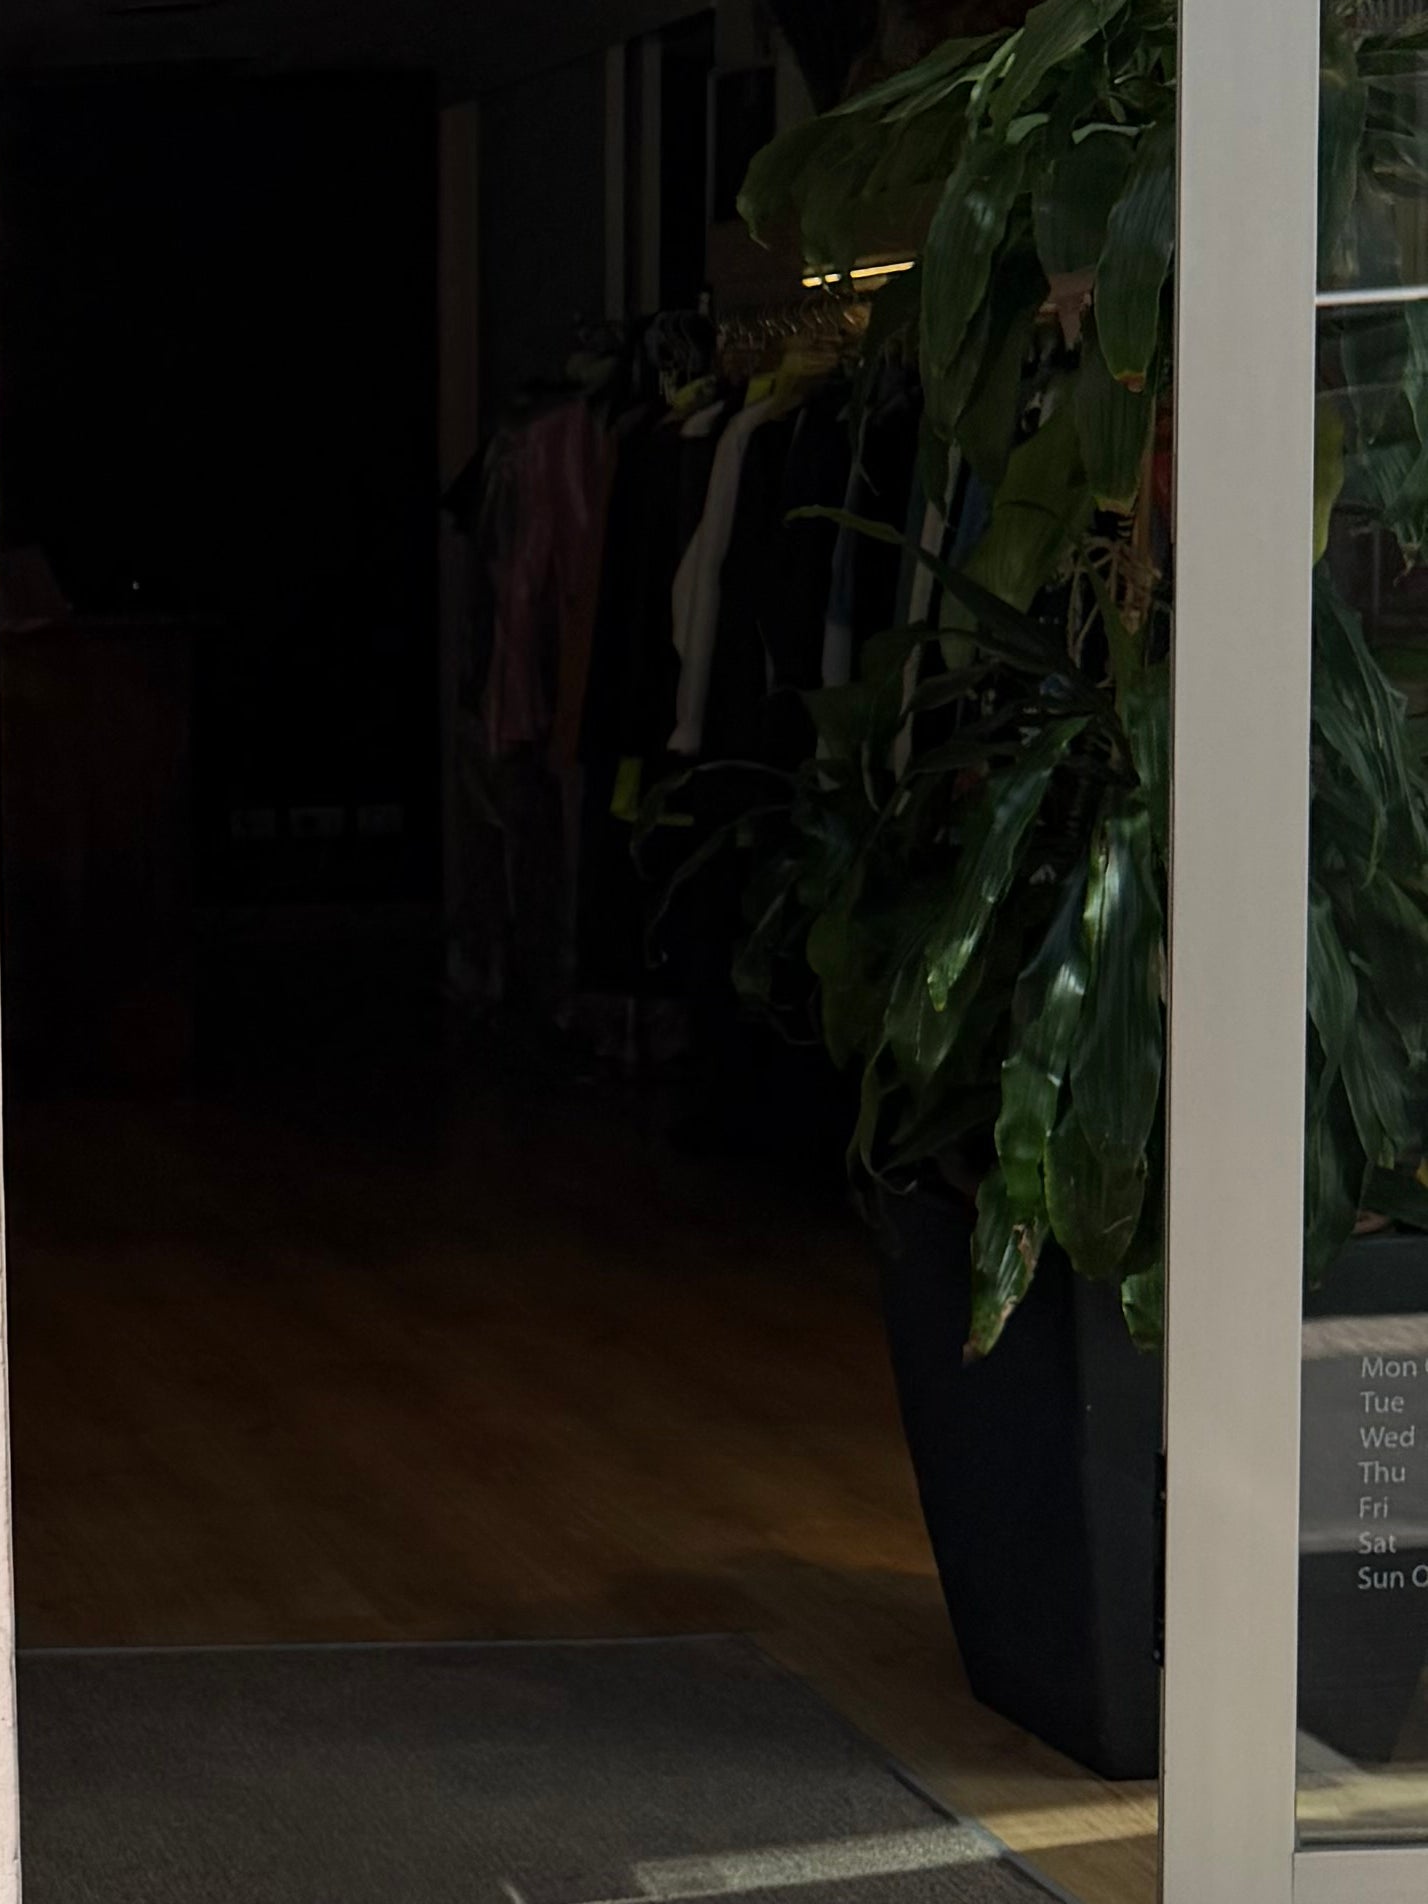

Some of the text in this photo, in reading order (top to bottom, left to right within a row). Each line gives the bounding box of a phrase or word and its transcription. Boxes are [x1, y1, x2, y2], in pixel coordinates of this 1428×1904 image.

[1361, 1356, 1418, 1378] Mon
[1359, 1391, 1405, 1414] Tue
[1360, 1425, 1415, 1448] Wed
[1358, 1460, 1406, 1483] Thu
[1359, 1495, 1389, 1519] Fri
[1358, 1530, 1397, 1554] Sat
[1357, 1565, 1404, 1589] Sun
